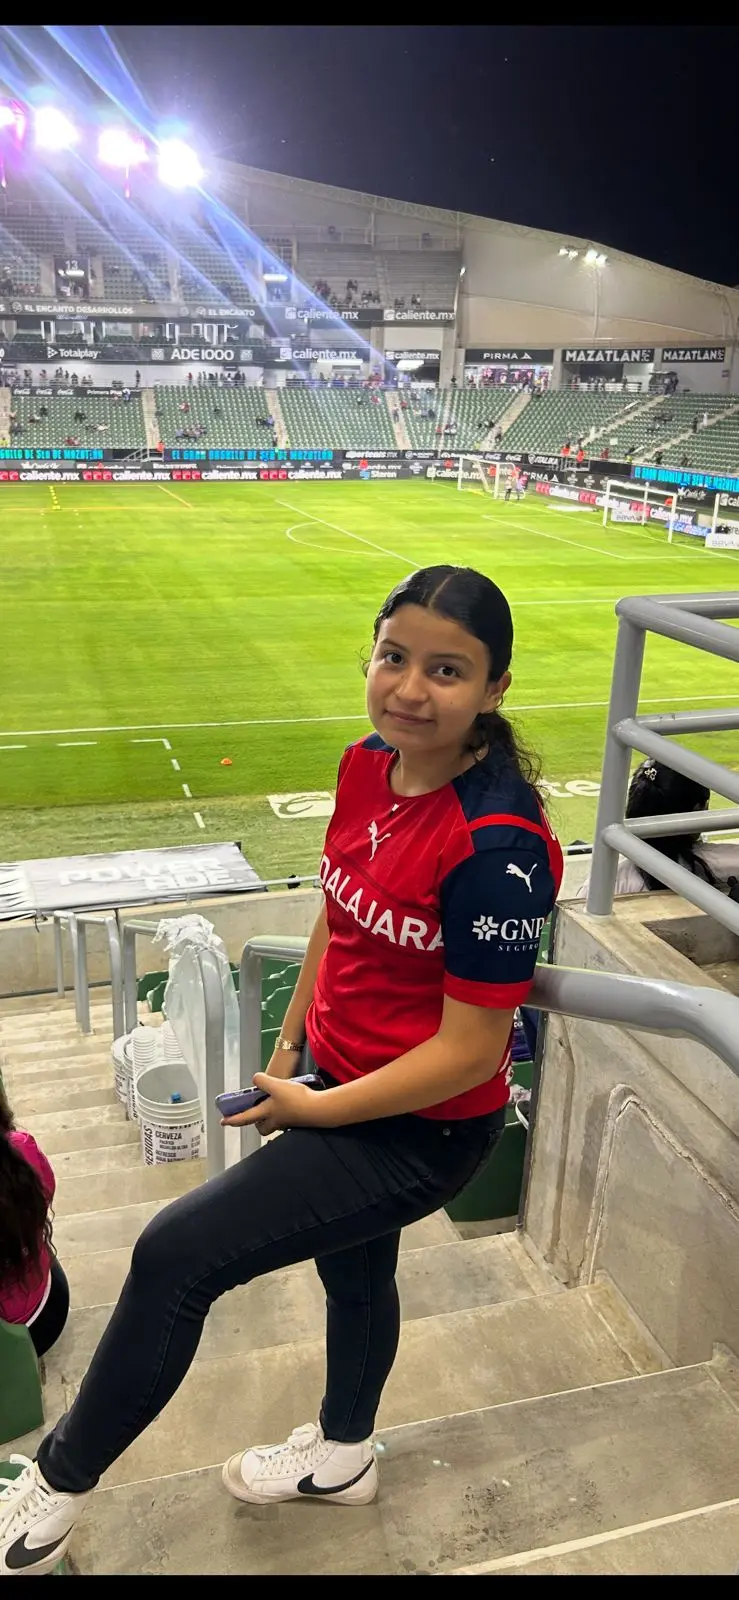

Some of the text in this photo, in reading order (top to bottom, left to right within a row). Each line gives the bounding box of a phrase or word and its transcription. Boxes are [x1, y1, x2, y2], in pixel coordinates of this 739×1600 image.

[65, 260, 78, 271] 13
[36, 305, 74, 313] ENCANTO
[297, 308, 359, 319] caliente.mx
[395, 310, 456, 320] caliente.mx
[59, 348, 98, 359] Totalplay
[293, 348, 357, 360] caliente.mx
[395, 351, 440, 359] caliente.mx
[20, 470, 80, 480] caliente.mx
[112, 470, 171, 480] caliente.mx
[201, 469, 257, 480] caliente.mx
[287, 469, 342, 480] caliente.mx
[59, 857, 224, 886] POWER
[501, 917, 544, 940] GNP
[156, 1131, 182, 1140] CERVEZA
